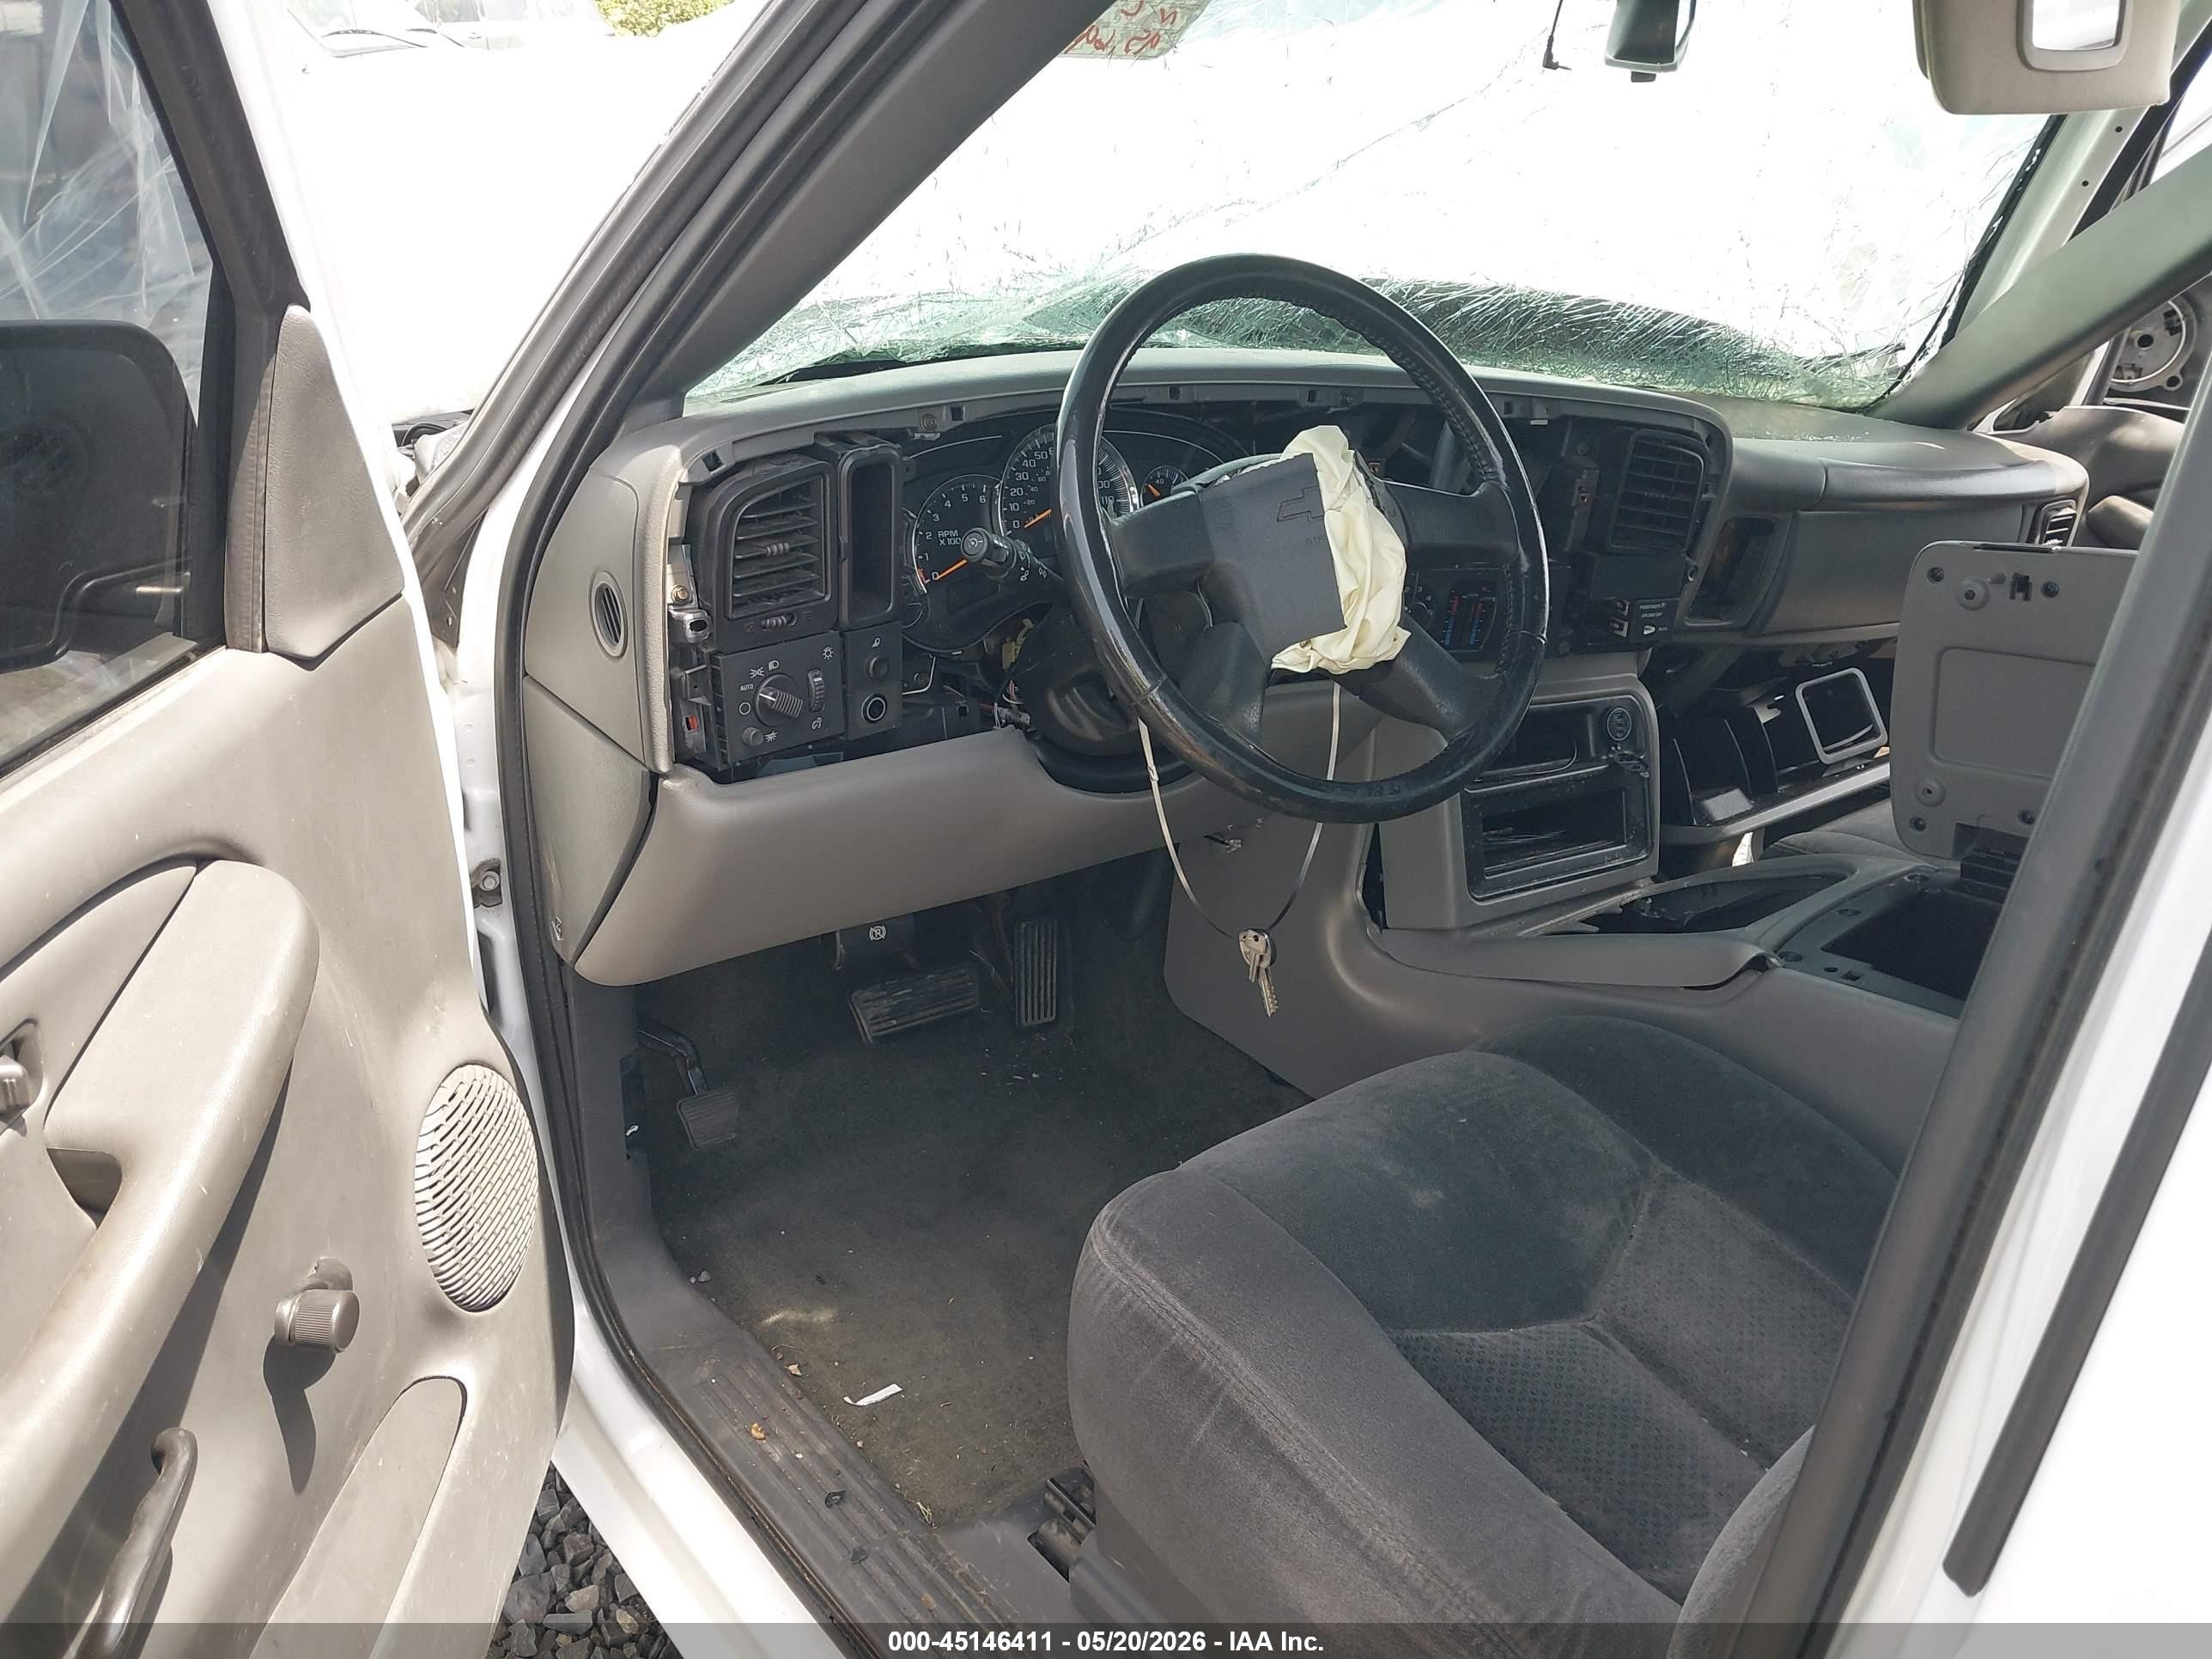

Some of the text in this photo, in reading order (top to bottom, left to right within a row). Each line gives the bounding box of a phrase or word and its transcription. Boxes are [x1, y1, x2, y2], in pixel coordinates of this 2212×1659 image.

[1034, 451, 1048, 460] 50
[1022, 459, 1036, 468] 40
[1015, 471, 1030, 481] 30
[1010, 487, 1024, 496] 20
[961, 494, 969, 502] 5
[979, 495, 987, 503] 6
[944, 500, 951, 508] 4
[1009, 502, 1019, 512] 10
[933, 514, 940, 522] 3
[1012, 520, 1020, 529] 0
[926, 532, 933, 540] 2
[938, 529, 959, 538] RPM
[931, 571, 939, 580] 0
[740, 683, 754, 692] AUTO
